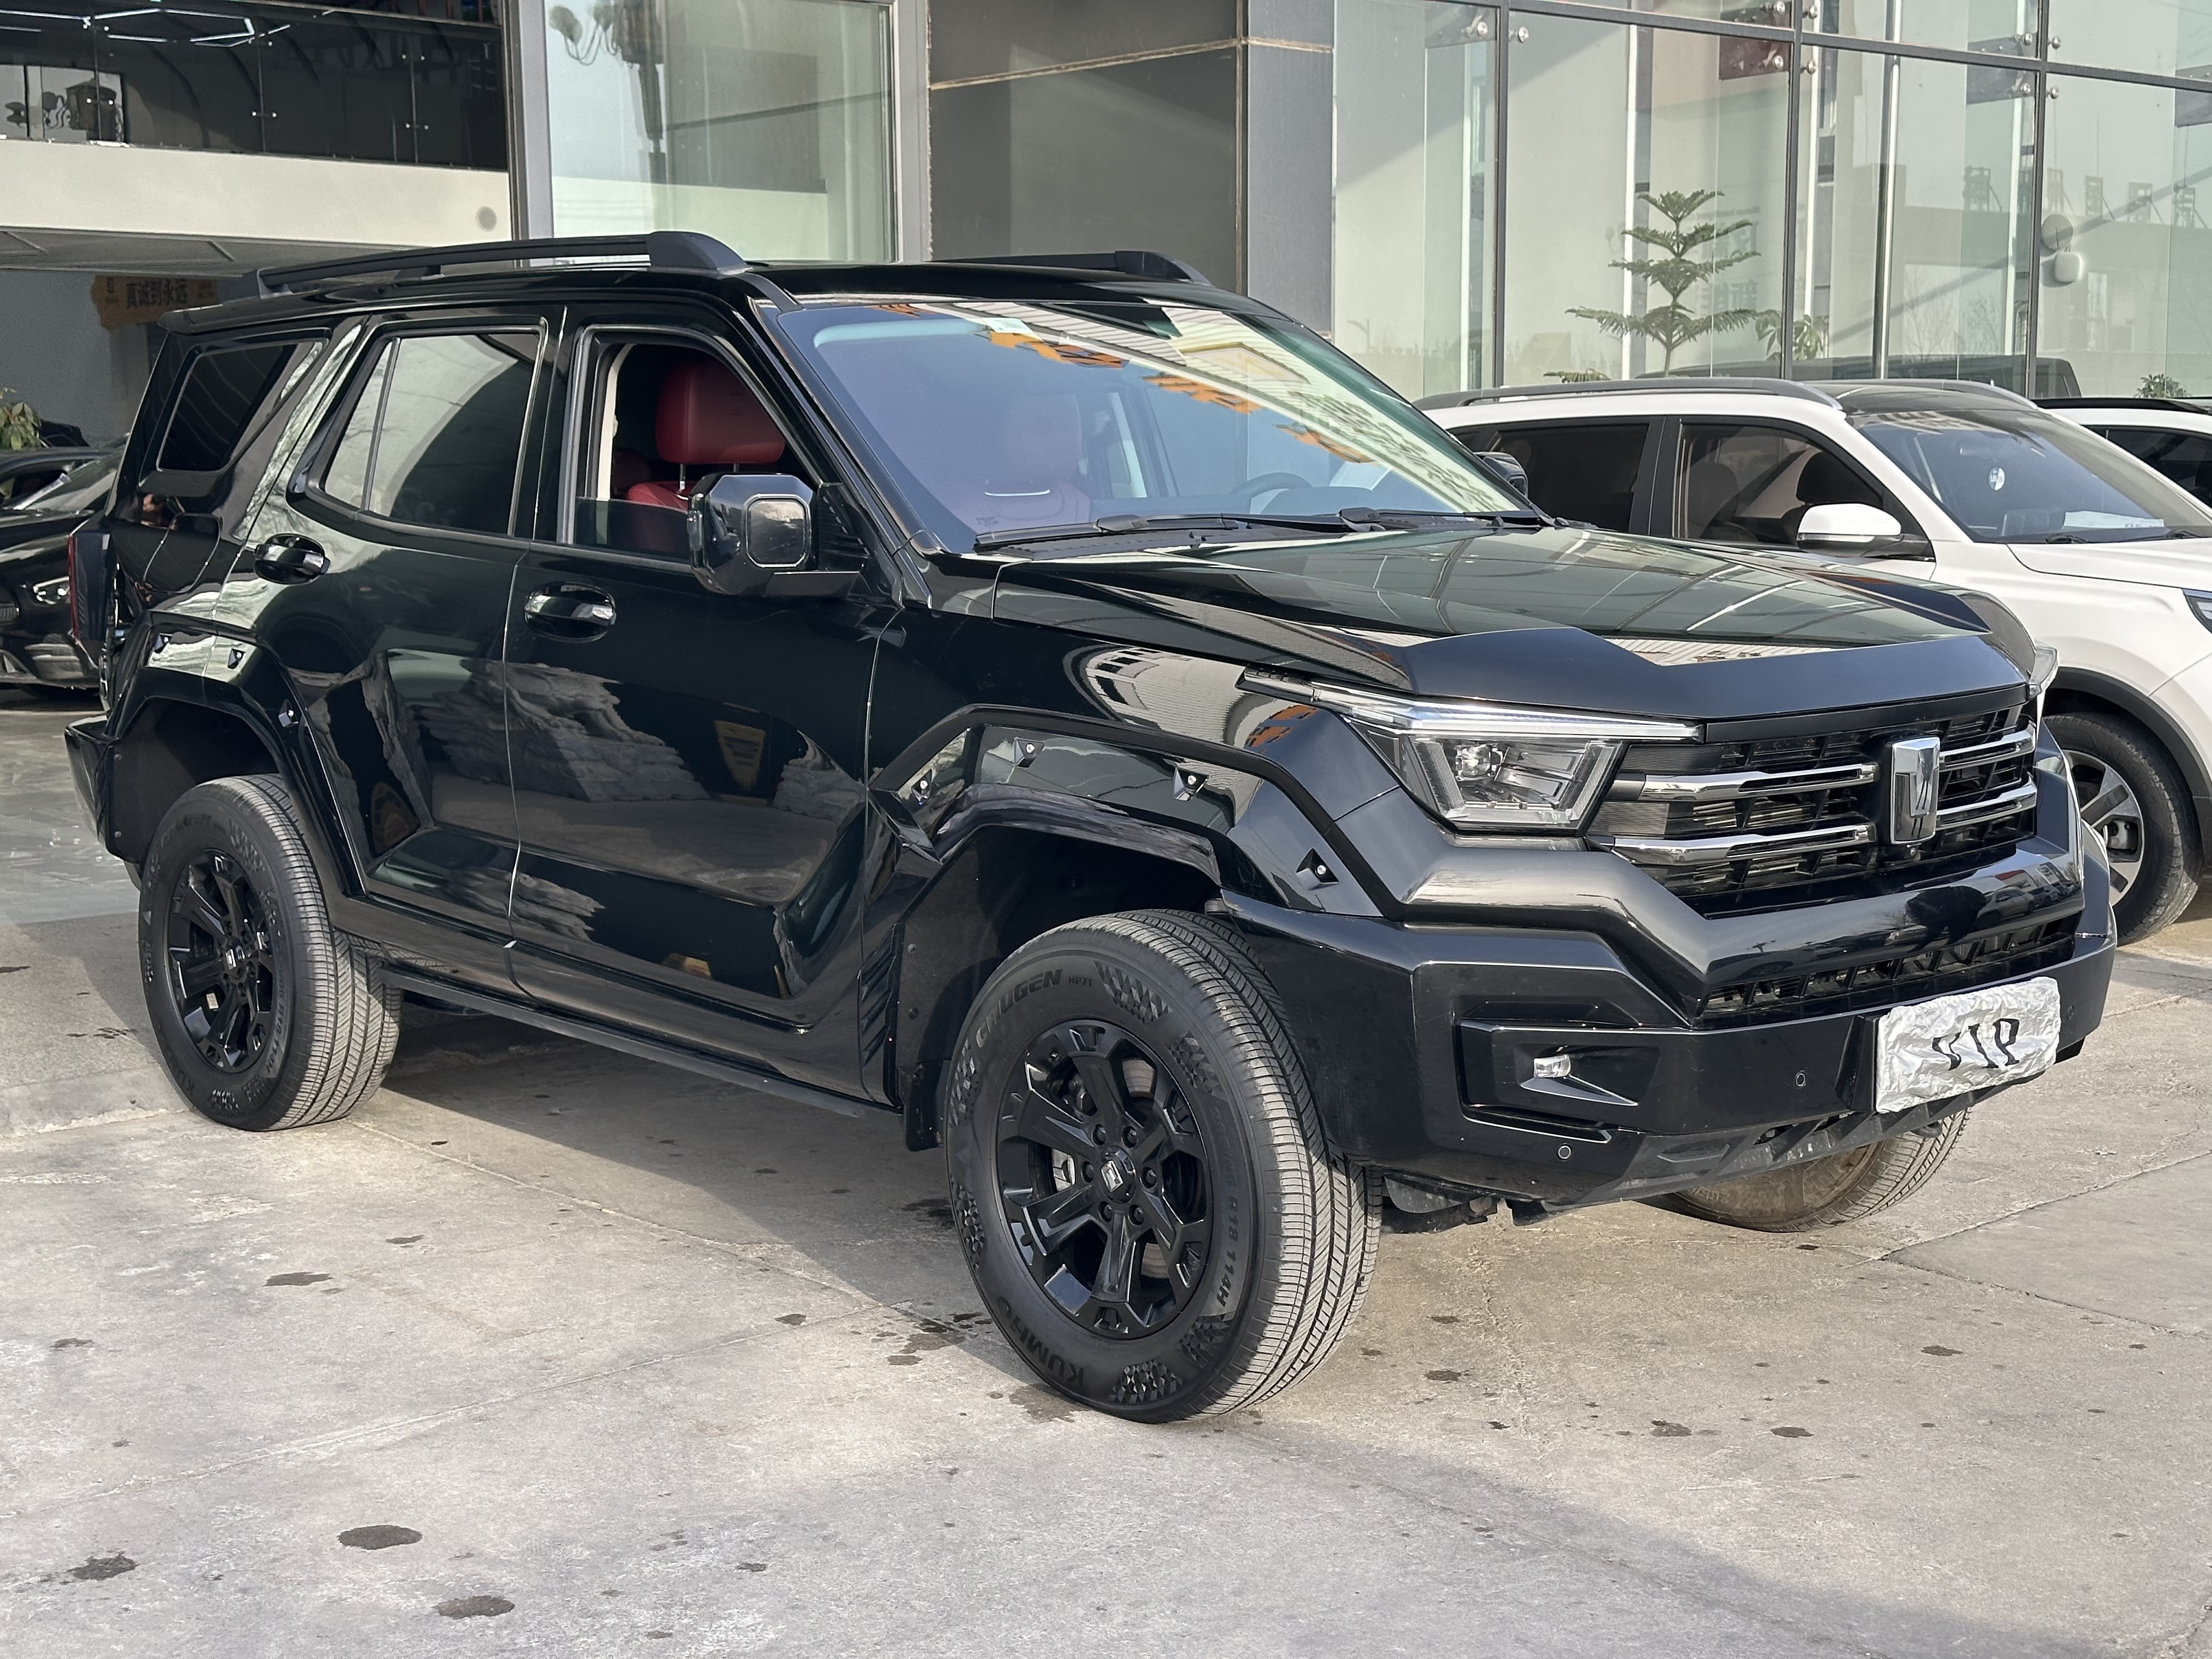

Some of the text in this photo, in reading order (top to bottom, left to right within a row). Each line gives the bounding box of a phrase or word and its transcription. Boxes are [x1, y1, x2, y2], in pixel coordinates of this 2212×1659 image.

[2106, 747, 2149, 793] KUMHO
[1068, 975, 1093, 987] HP71
[1208, 1106, 1239, 1307] 265/65 R18 114H
[995, 1296, 1085, 1387] KUMHO
